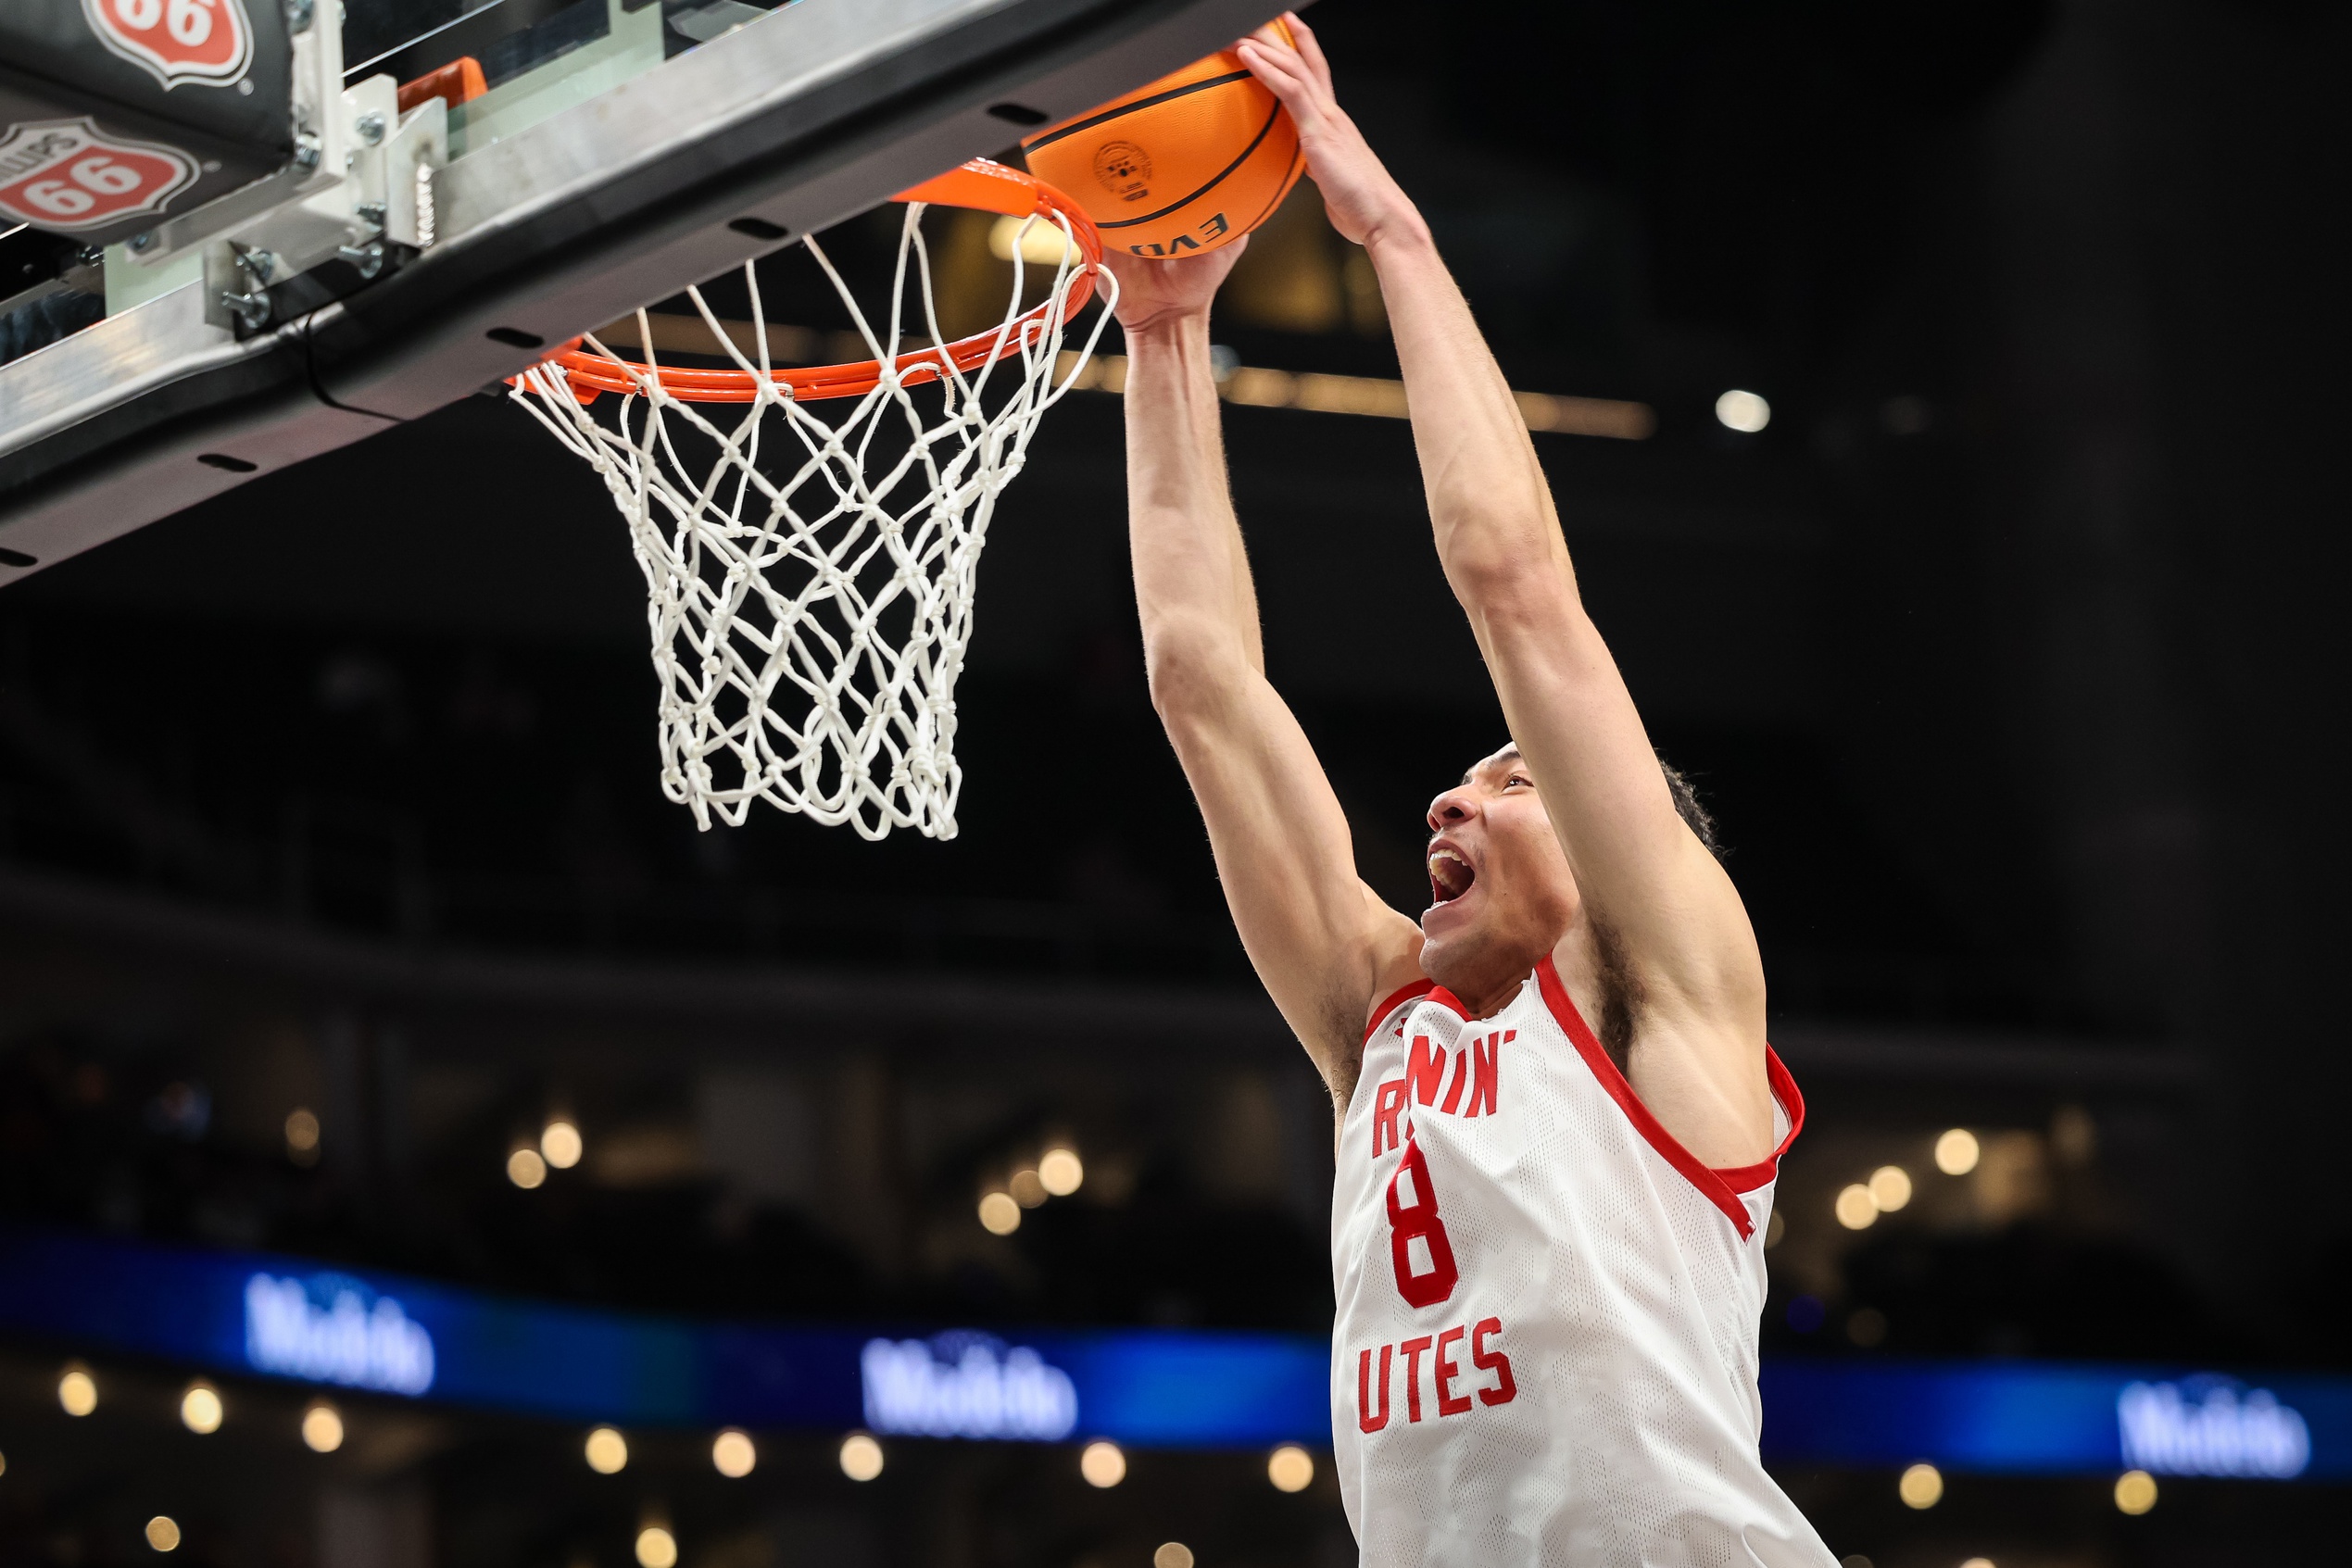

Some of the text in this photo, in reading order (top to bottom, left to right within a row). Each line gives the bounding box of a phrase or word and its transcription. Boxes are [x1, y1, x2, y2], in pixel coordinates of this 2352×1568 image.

[114, 0, 215, 46] 66
[22, 156, 143, 215] 66
[1387, 1137, 1459, 1308] 8
[1358, 1316, 1517, 1435] UTES
